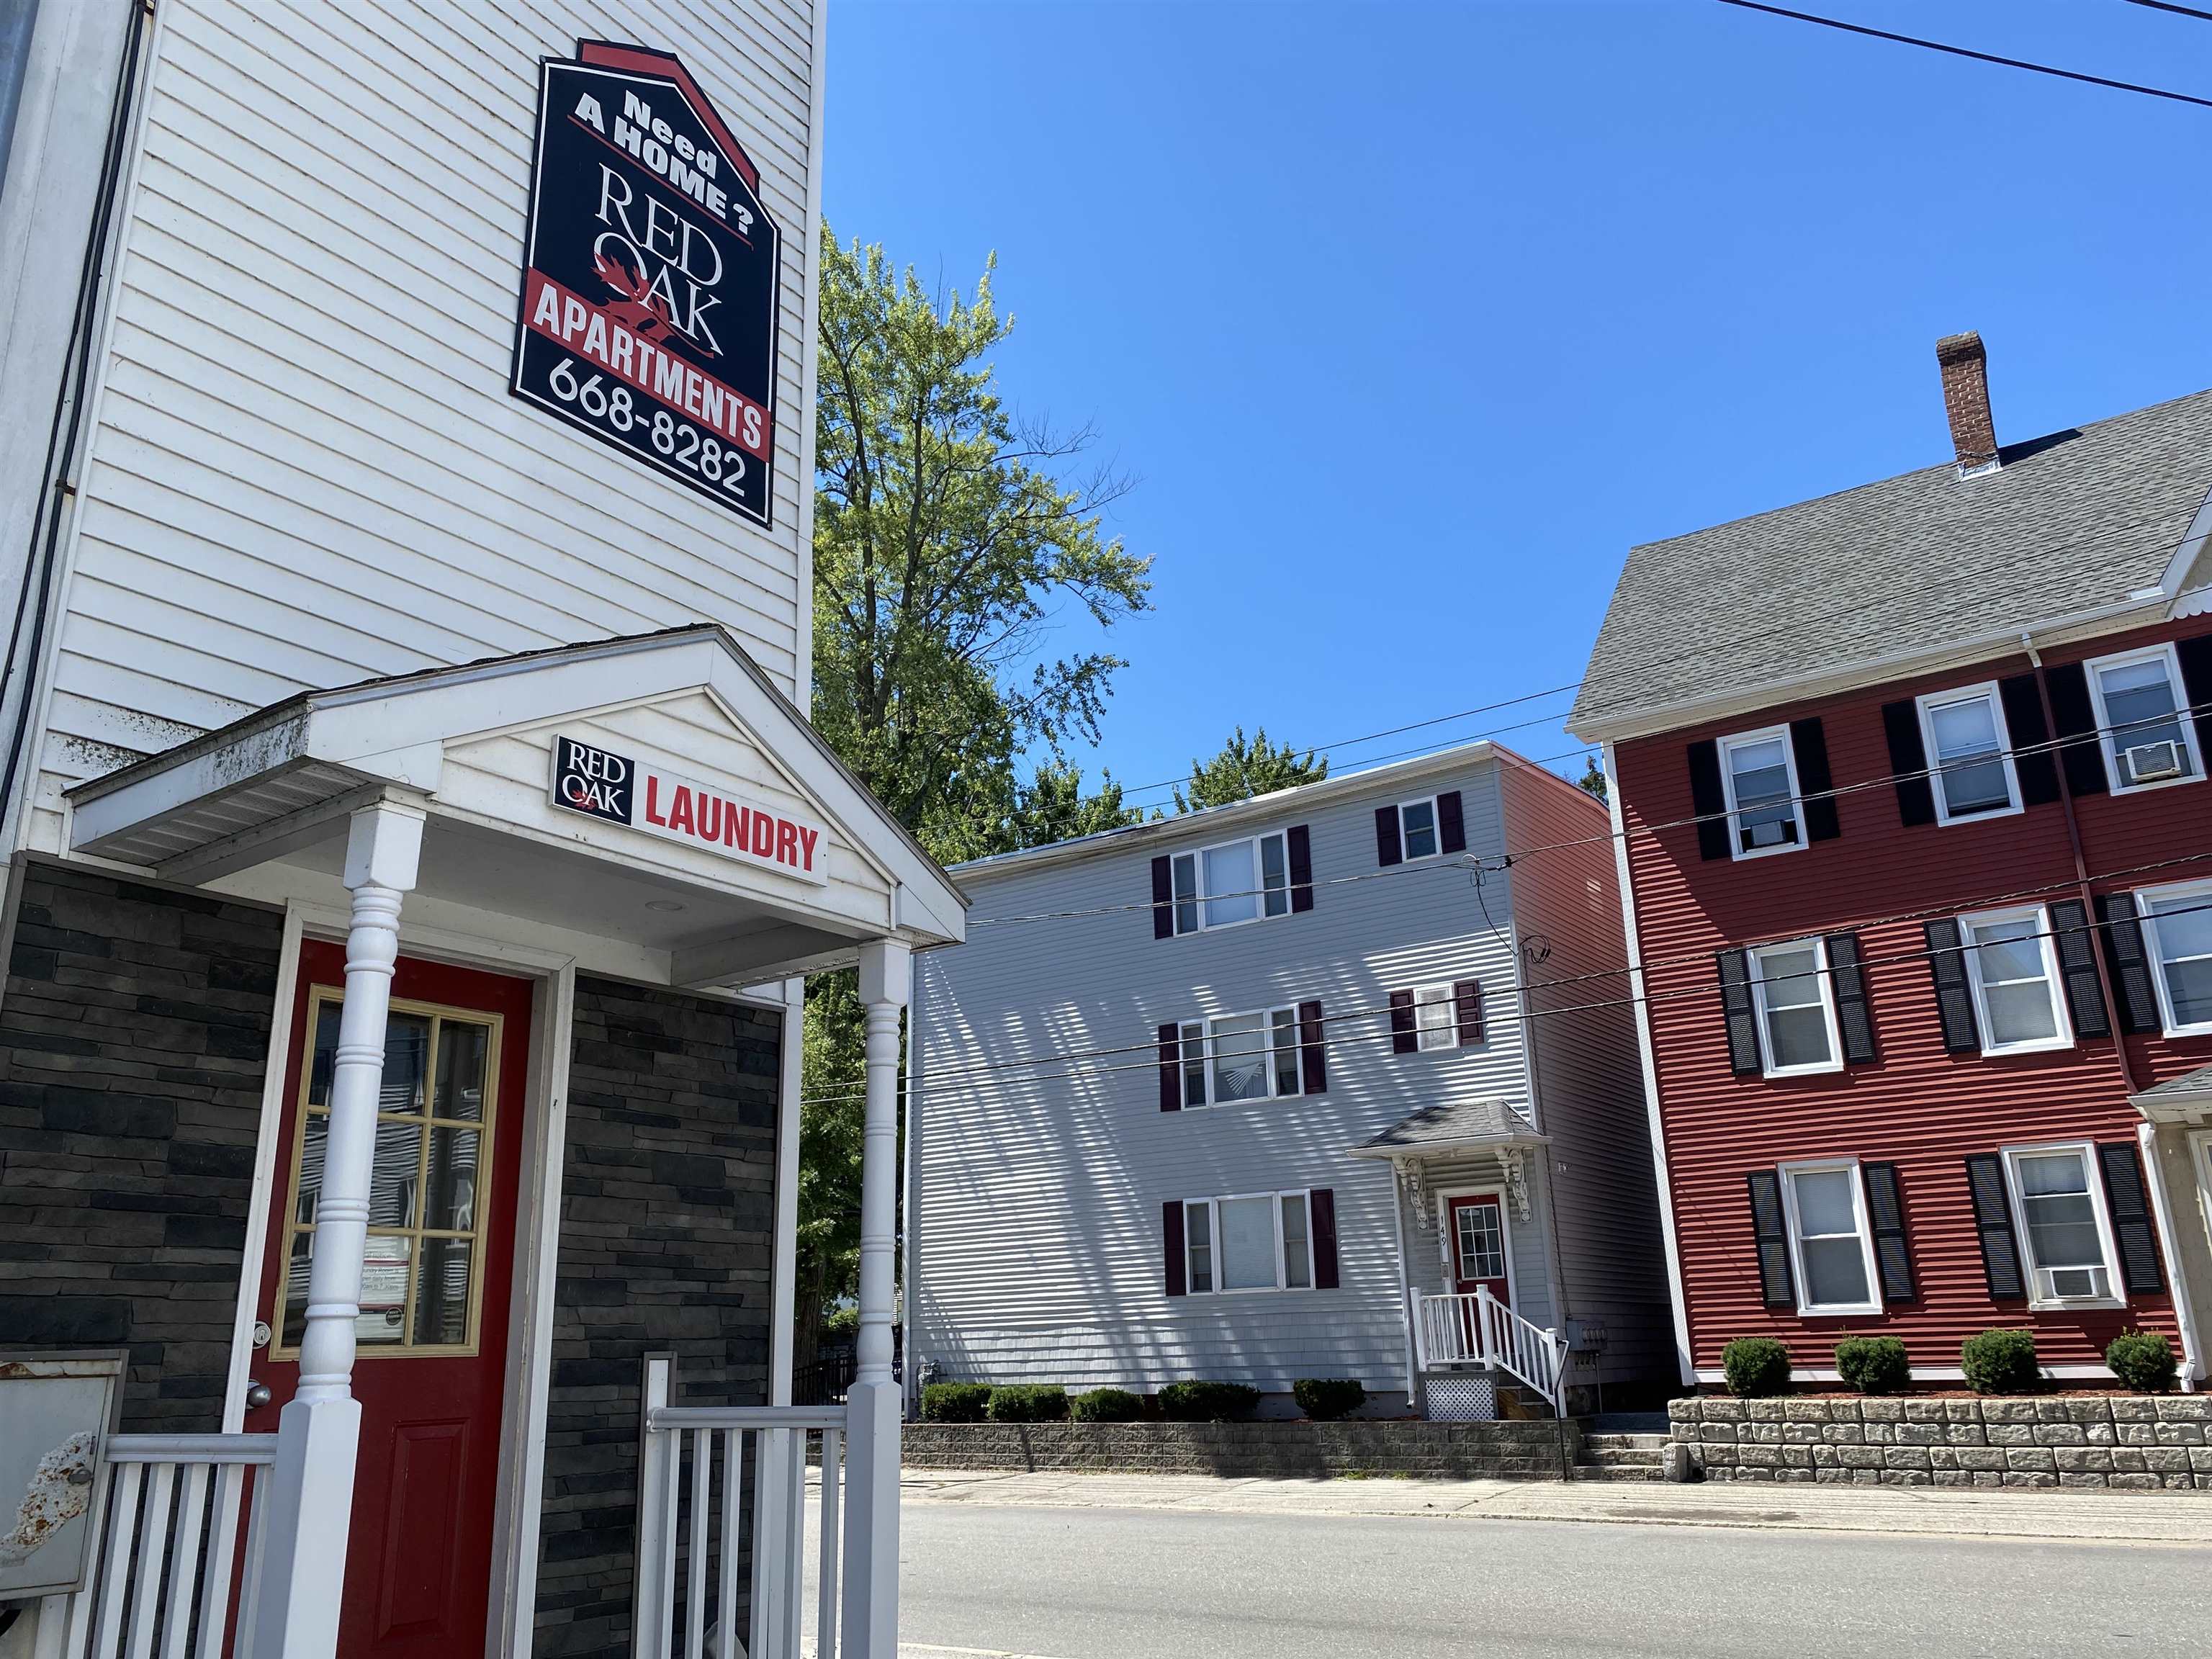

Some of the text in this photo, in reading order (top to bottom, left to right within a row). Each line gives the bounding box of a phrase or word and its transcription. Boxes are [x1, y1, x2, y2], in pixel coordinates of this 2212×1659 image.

[575, 92, 605, 134] A
[624, 90, 717, 179] Need
[595, 163, 722, 286] RED
[594, 232, 724, 356] OAK
[533, 282, 762, 449] APARTMENTS
[549, 358, 746, 497] 668-8282
[562, 774, 626, 817] OAK
[567, 741, 626, 783] RED
[645, 775, 819, 872] LAUNDRY
